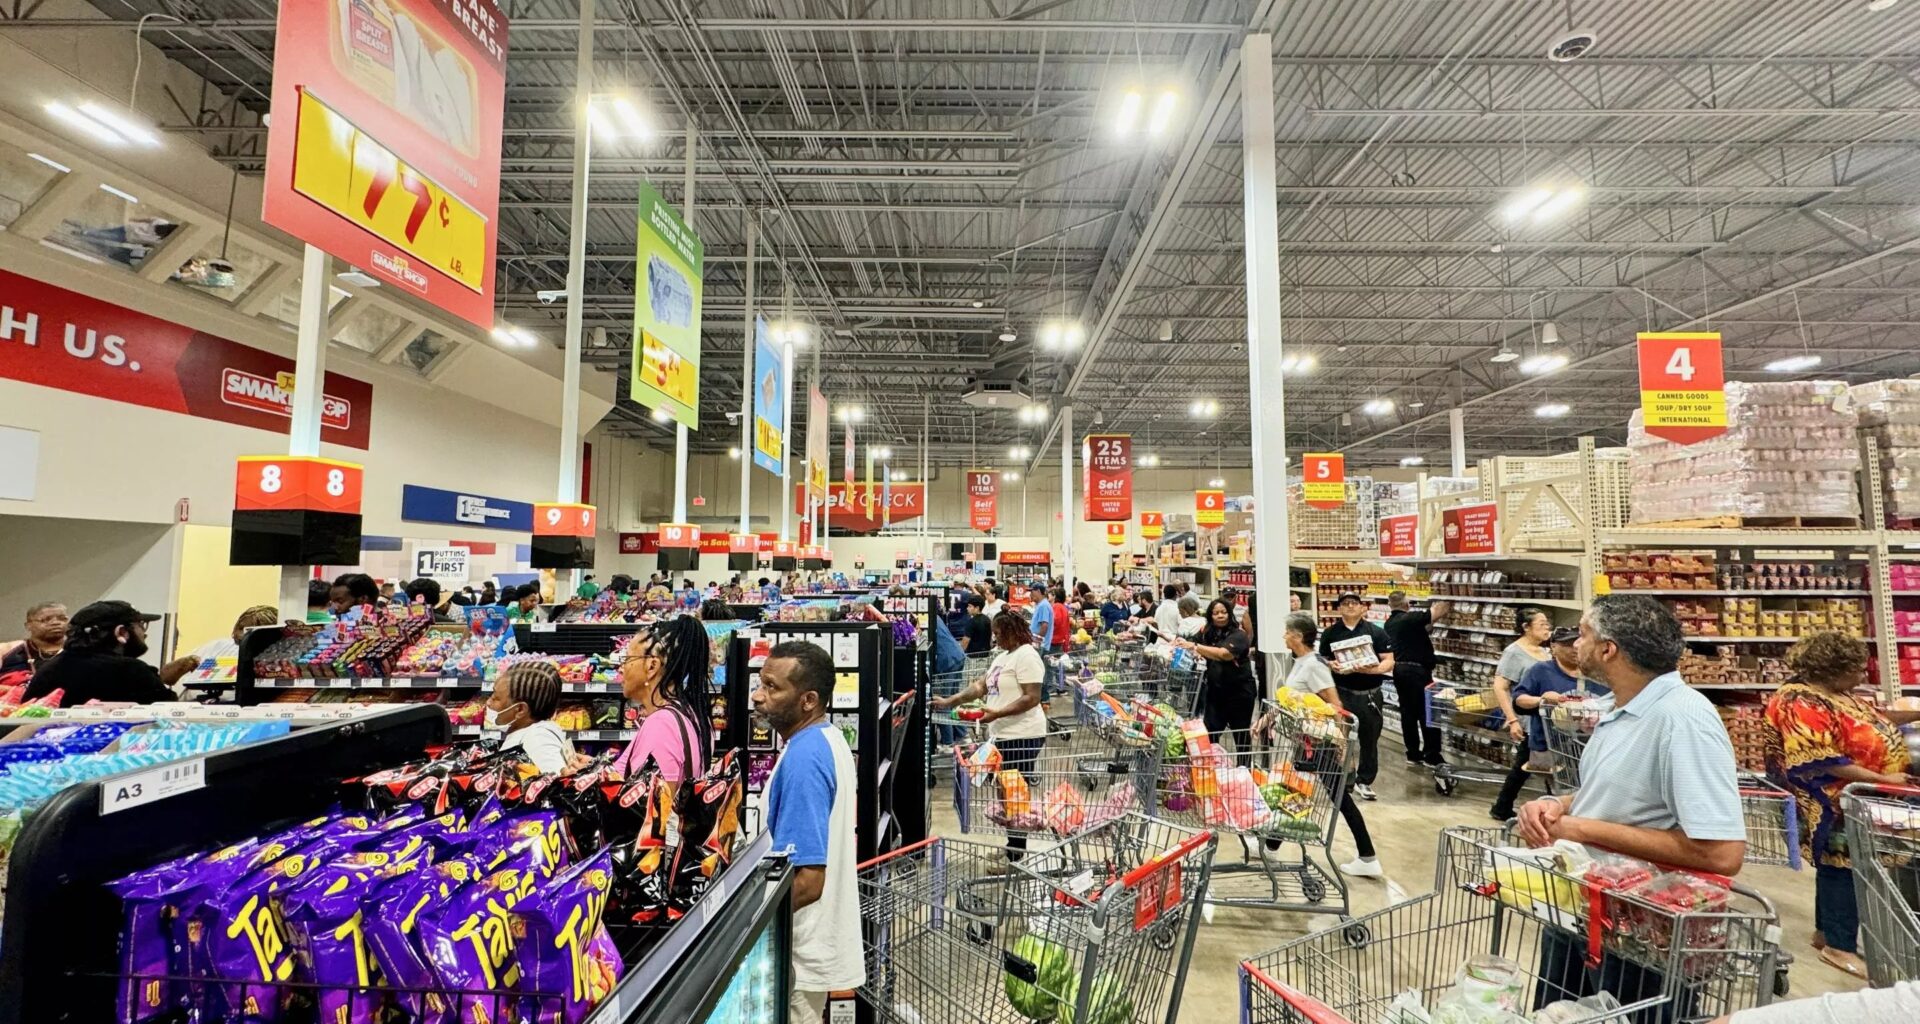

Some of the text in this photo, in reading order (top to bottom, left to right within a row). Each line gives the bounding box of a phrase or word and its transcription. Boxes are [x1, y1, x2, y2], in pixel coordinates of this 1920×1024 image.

[361, 21, 382, 39] SPLIT
[450, 257, 464, 276] LB.
[403, 268, 427, 287] SHOP
[64, 322, 142, 372] US.
[1665, 347, 1696, 381] 4
[1659, 416, 1711, 424] INTERNATIONAL
[1097, 440, 1123, 456] 25
[1094, 456, 1127, 465] ITEMS
[1317, 461, 1330, 479] 5
[260, 464, 344, 496] 8 8
[976, 474, 991, 485] 10
[1098, 479, 1124, 490] Self
[975, 500, 993, 508] Self
[1205, 495, 1216, 508] 6
[547, 508, 591, 527] 9 9
[1147, 515, 1156, 523] 7
[666, 527, 682, 539] 10
[434, 562, 465, 572] FIRST
[115, 783, 143, 803] A3
